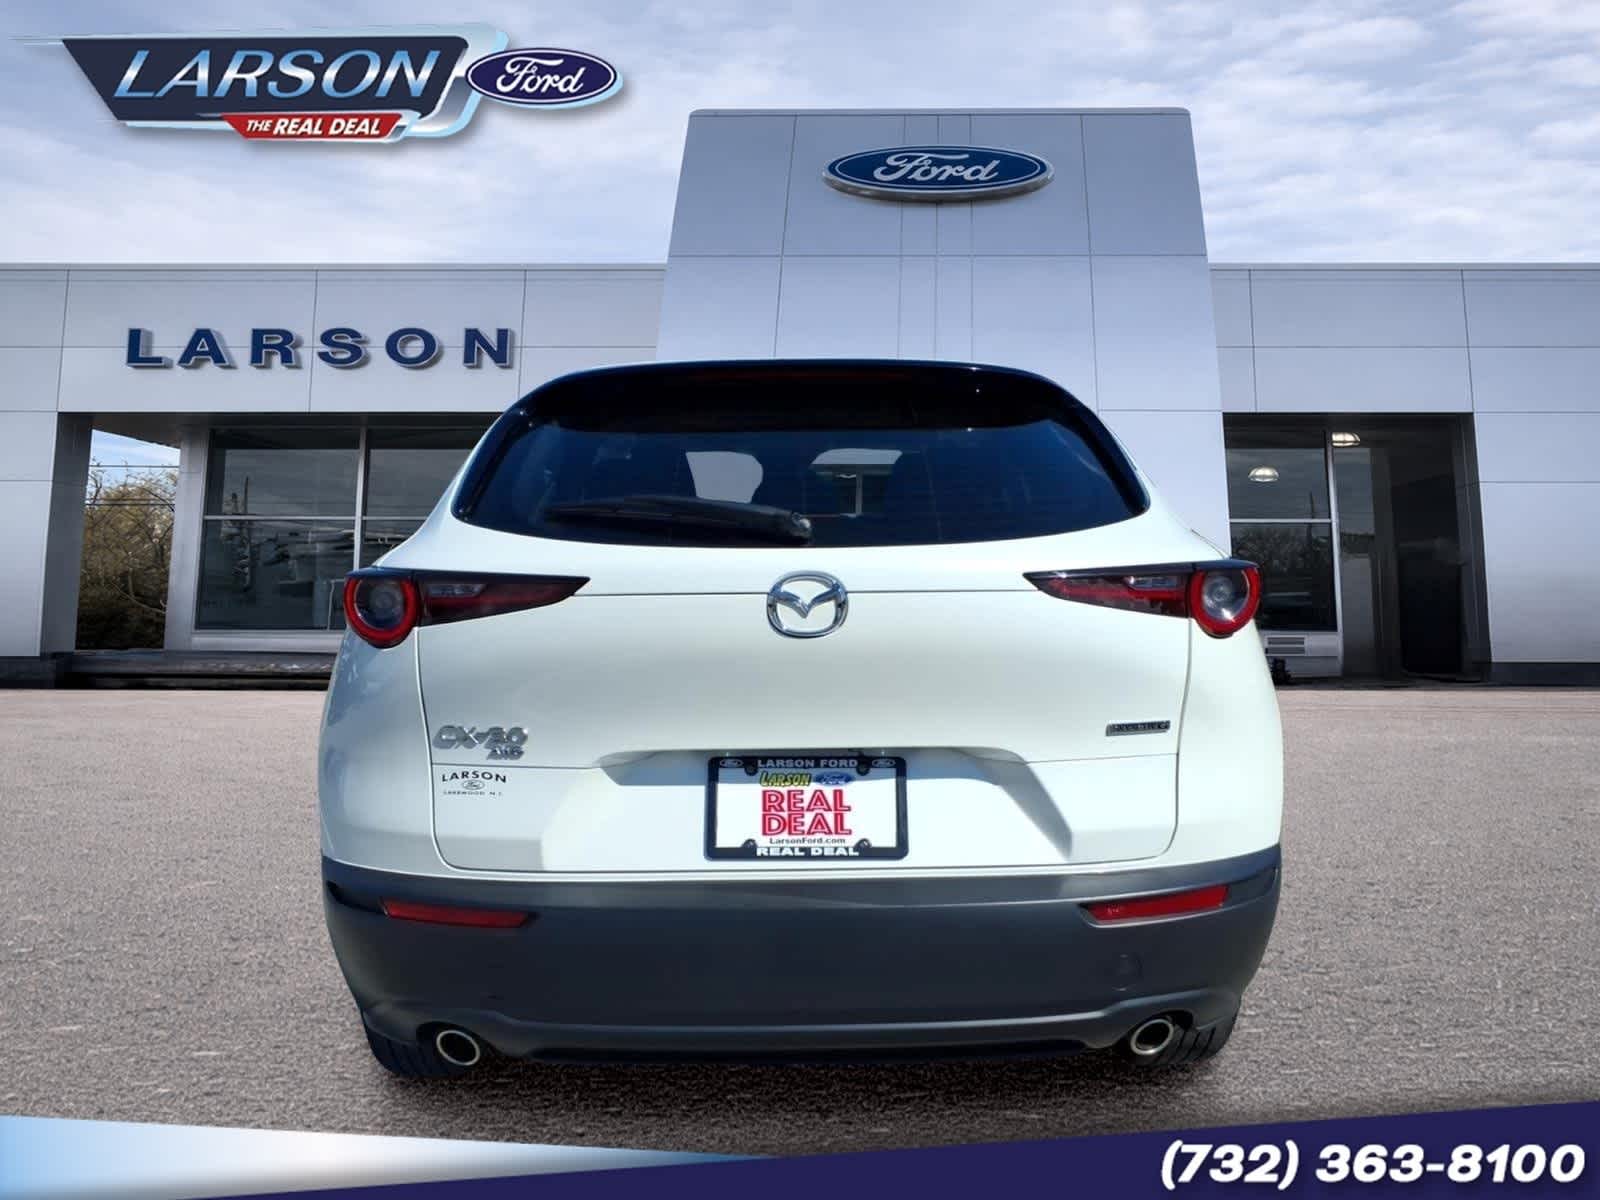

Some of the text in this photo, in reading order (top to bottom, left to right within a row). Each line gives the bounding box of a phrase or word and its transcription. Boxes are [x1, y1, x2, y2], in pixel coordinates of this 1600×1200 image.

[872, 152, 1001, 182] Ford
[126, 327, 514, 368] LARSON
[757, 758, 859, 768] LARSON FORD
[441, 770, 507, 783] LARSON
[758, 771, 813, 787] LARSON
[761, 789, 852, 813] REAL
[761, 812, 853, 836] DEAL
[769, 837, 846, 845] LarsonFord.com
[756, 846, 860, 856] REAL DEAL
